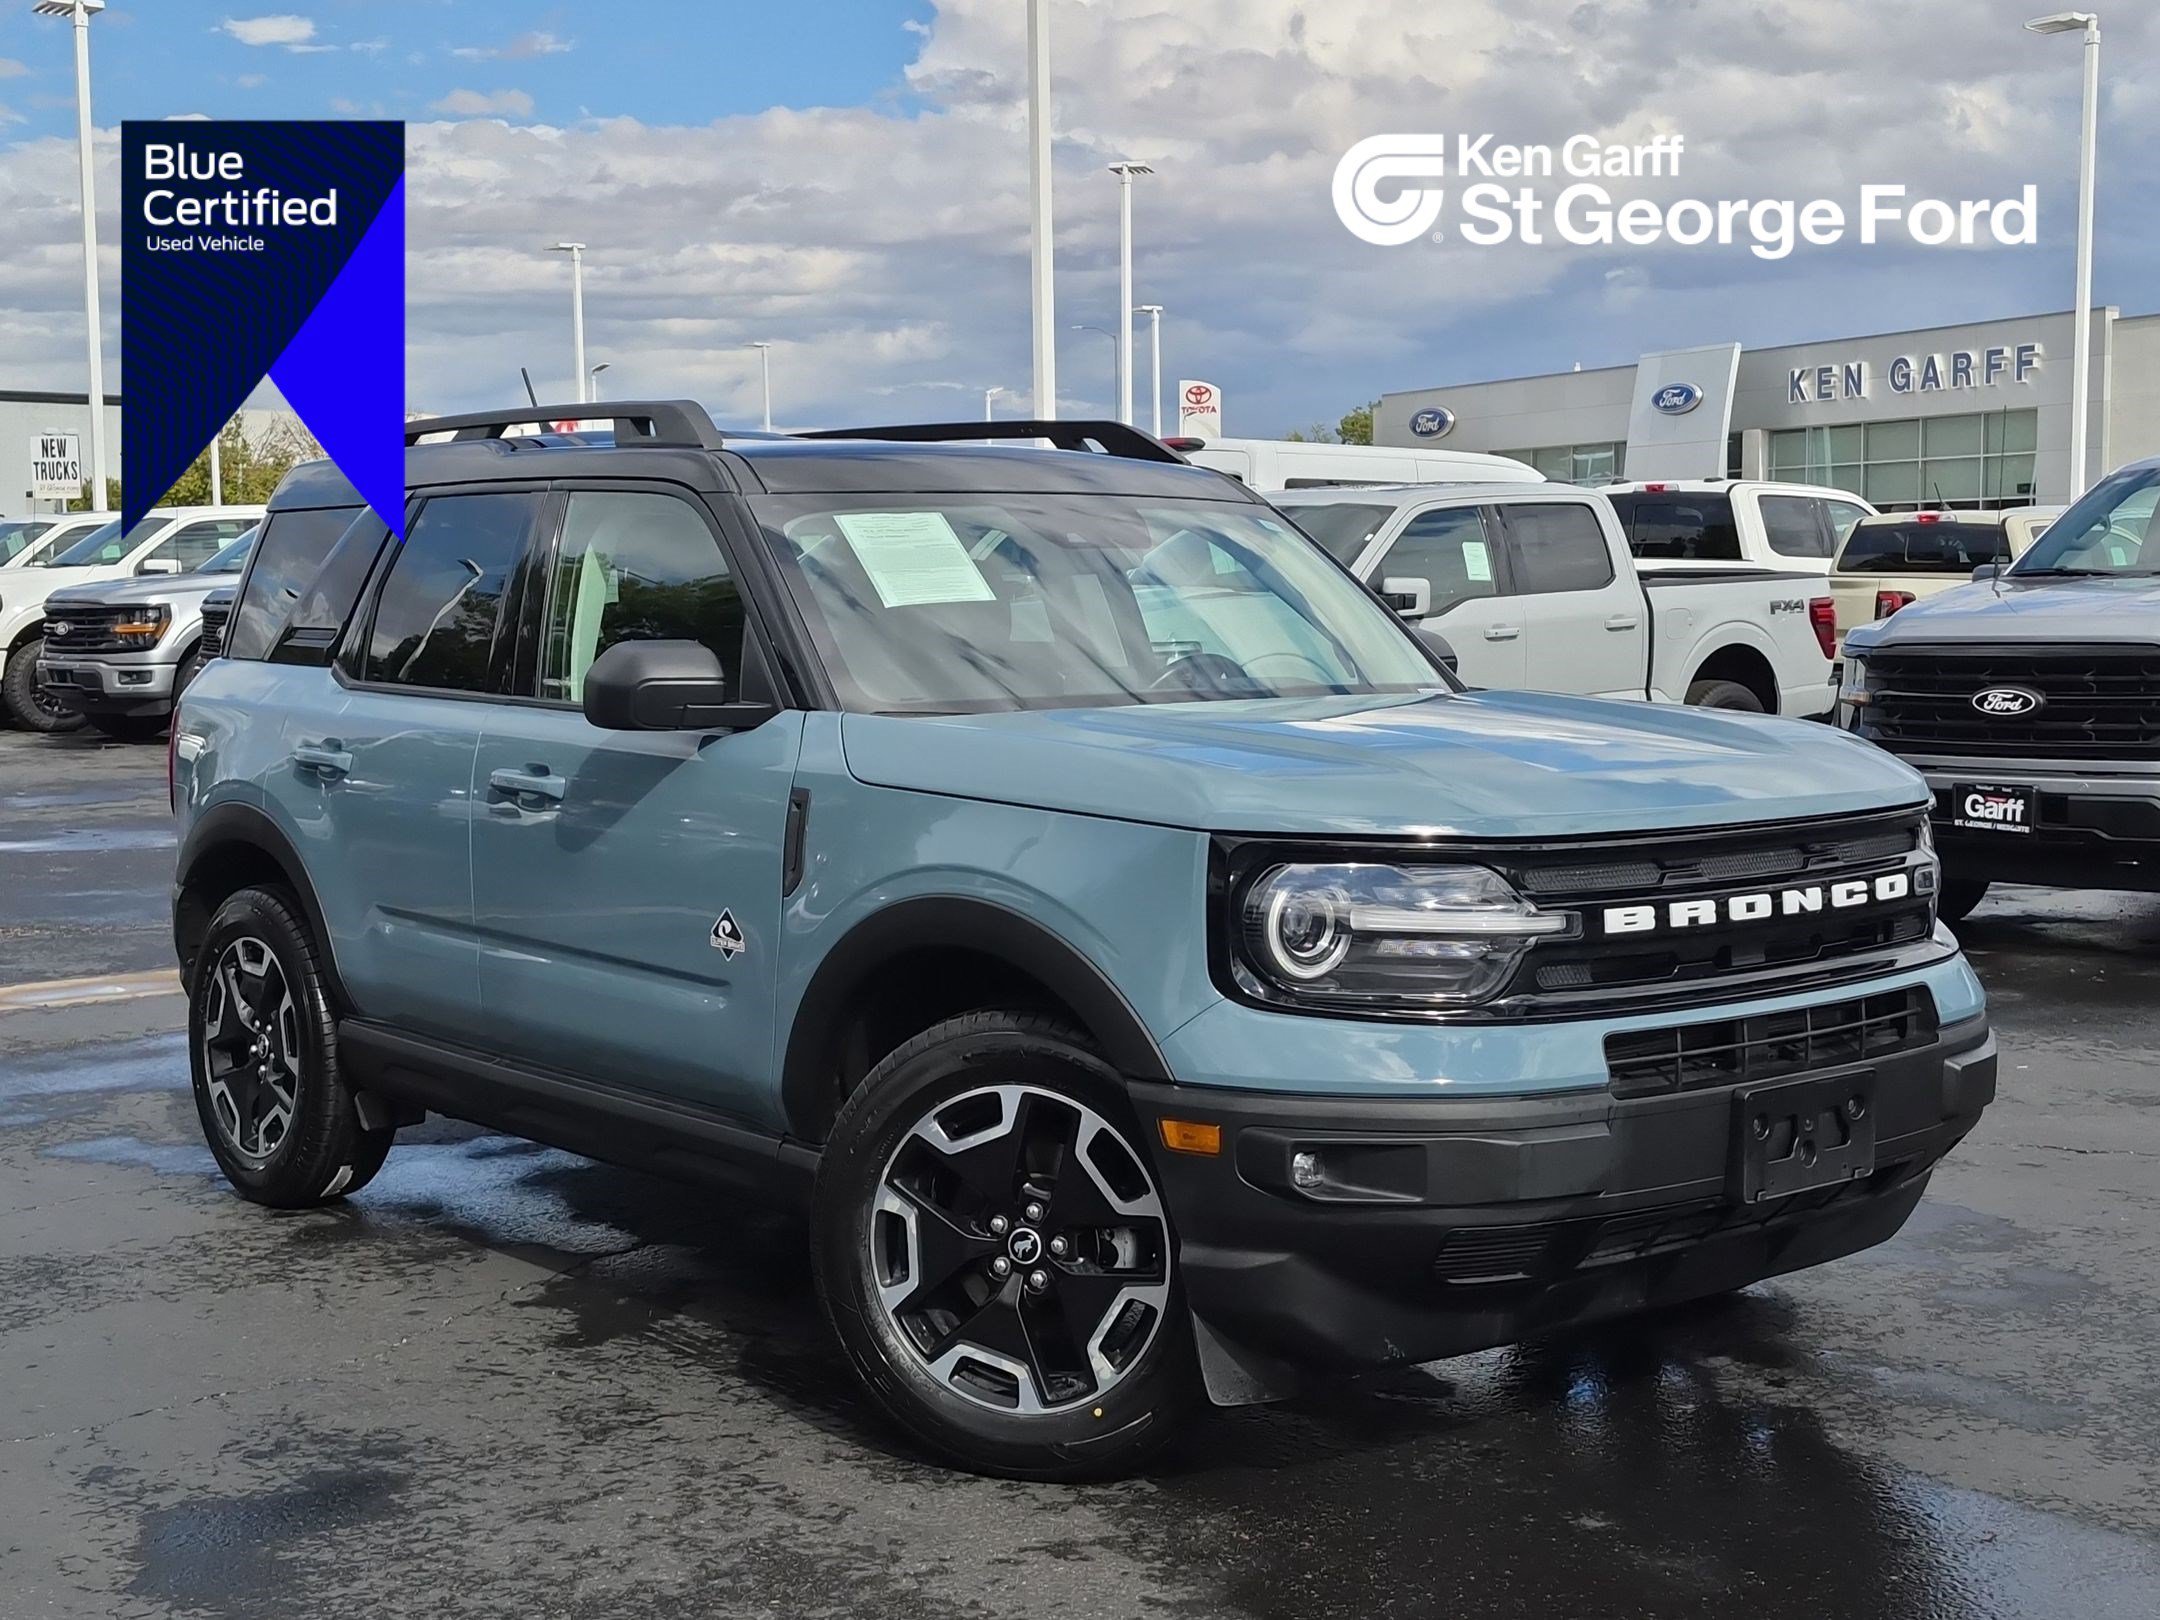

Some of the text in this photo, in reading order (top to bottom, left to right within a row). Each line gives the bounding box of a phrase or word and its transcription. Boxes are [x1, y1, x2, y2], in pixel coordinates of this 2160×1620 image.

[1788, 344, 2040, 403] KEN GARFF
[1658, 388, 1687, 408] Ford
[1415, 413, 1441, 433] Ford
[41, 438, 67, 458] NEW
[33, 461, 78, 481] TRUCKS
[1770, 599, 1805, 615] FX4
[1983, 692, 2024, 711] Ford
[1965, 794, 2024, 822] Garff
[1603, 873, 1908, 934] BRONCO
